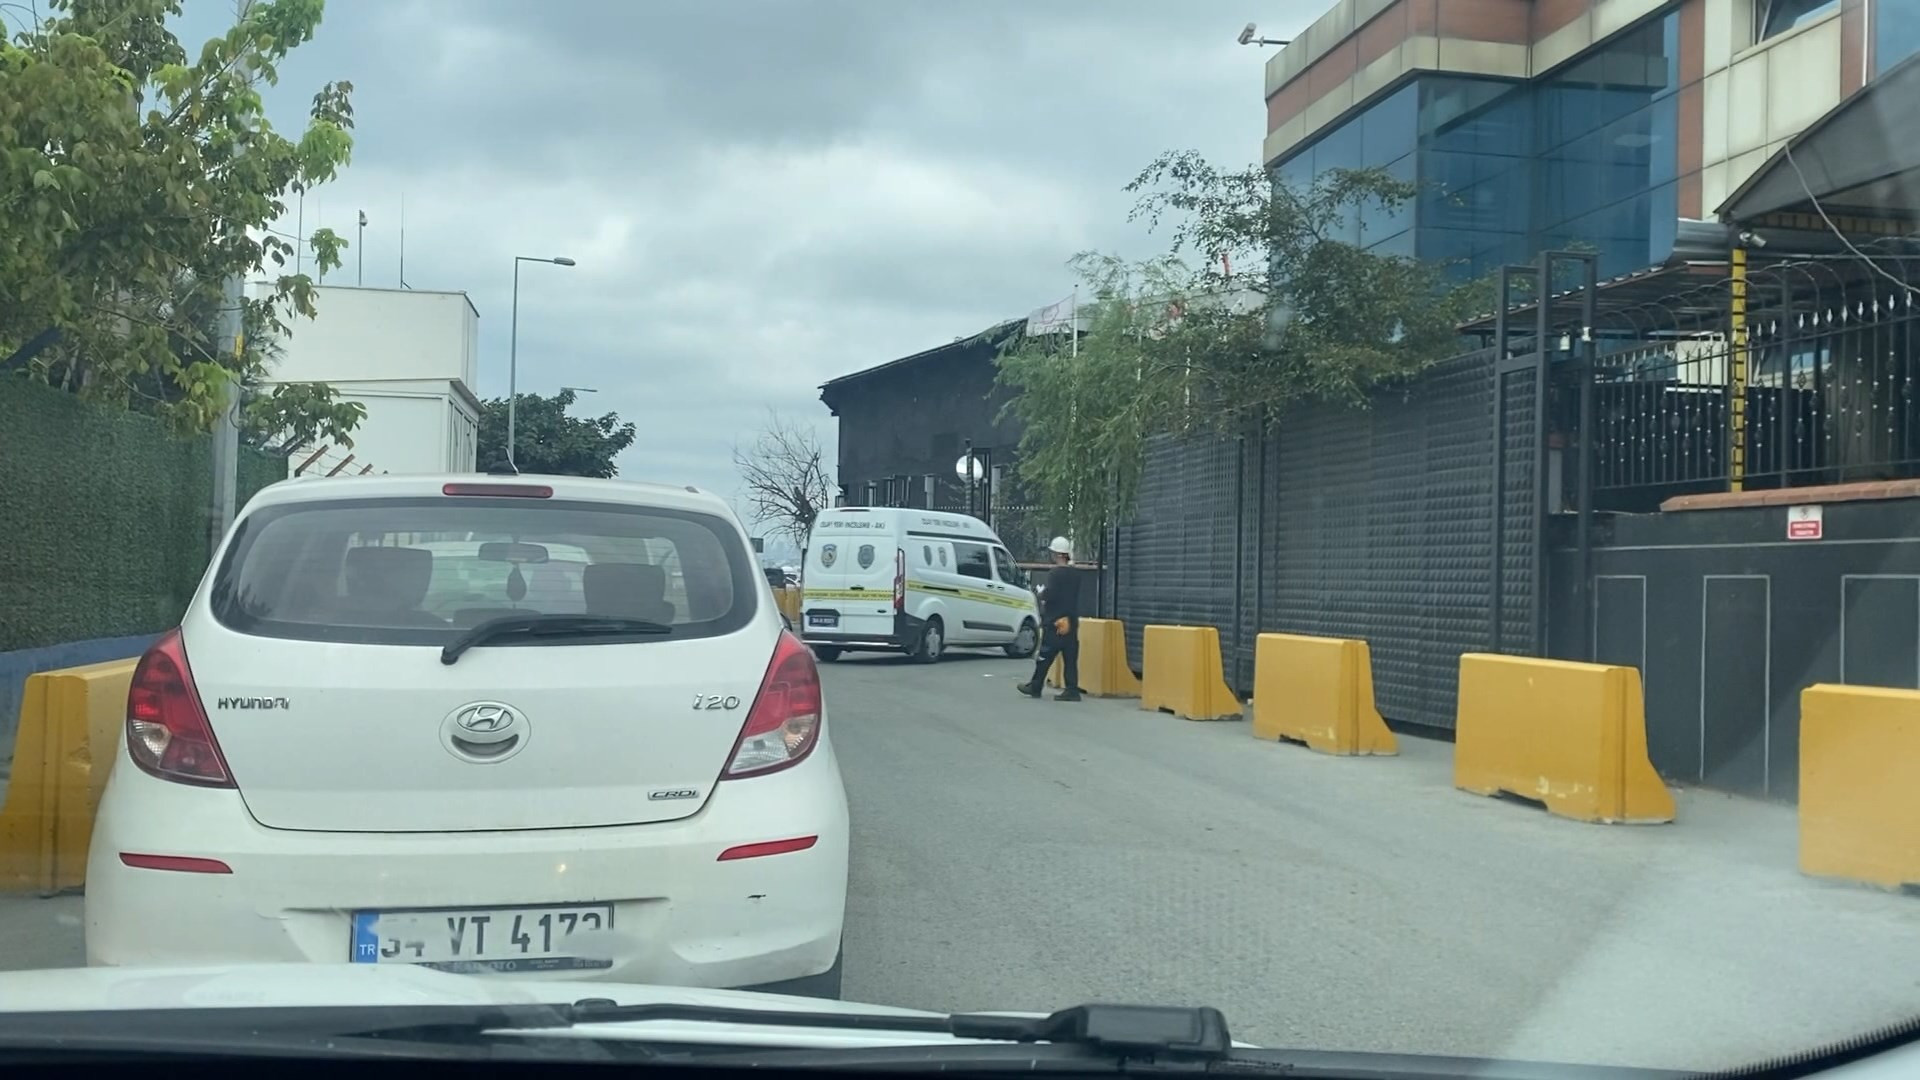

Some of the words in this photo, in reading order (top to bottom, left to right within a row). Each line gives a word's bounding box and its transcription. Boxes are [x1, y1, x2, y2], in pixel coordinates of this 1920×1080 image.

[217, 697, 290, 710] HYUNDAI
[692, 693, 741, 710] i20
[447, 915, 491, 956] VT
[360, 944, 376, 956] TR
